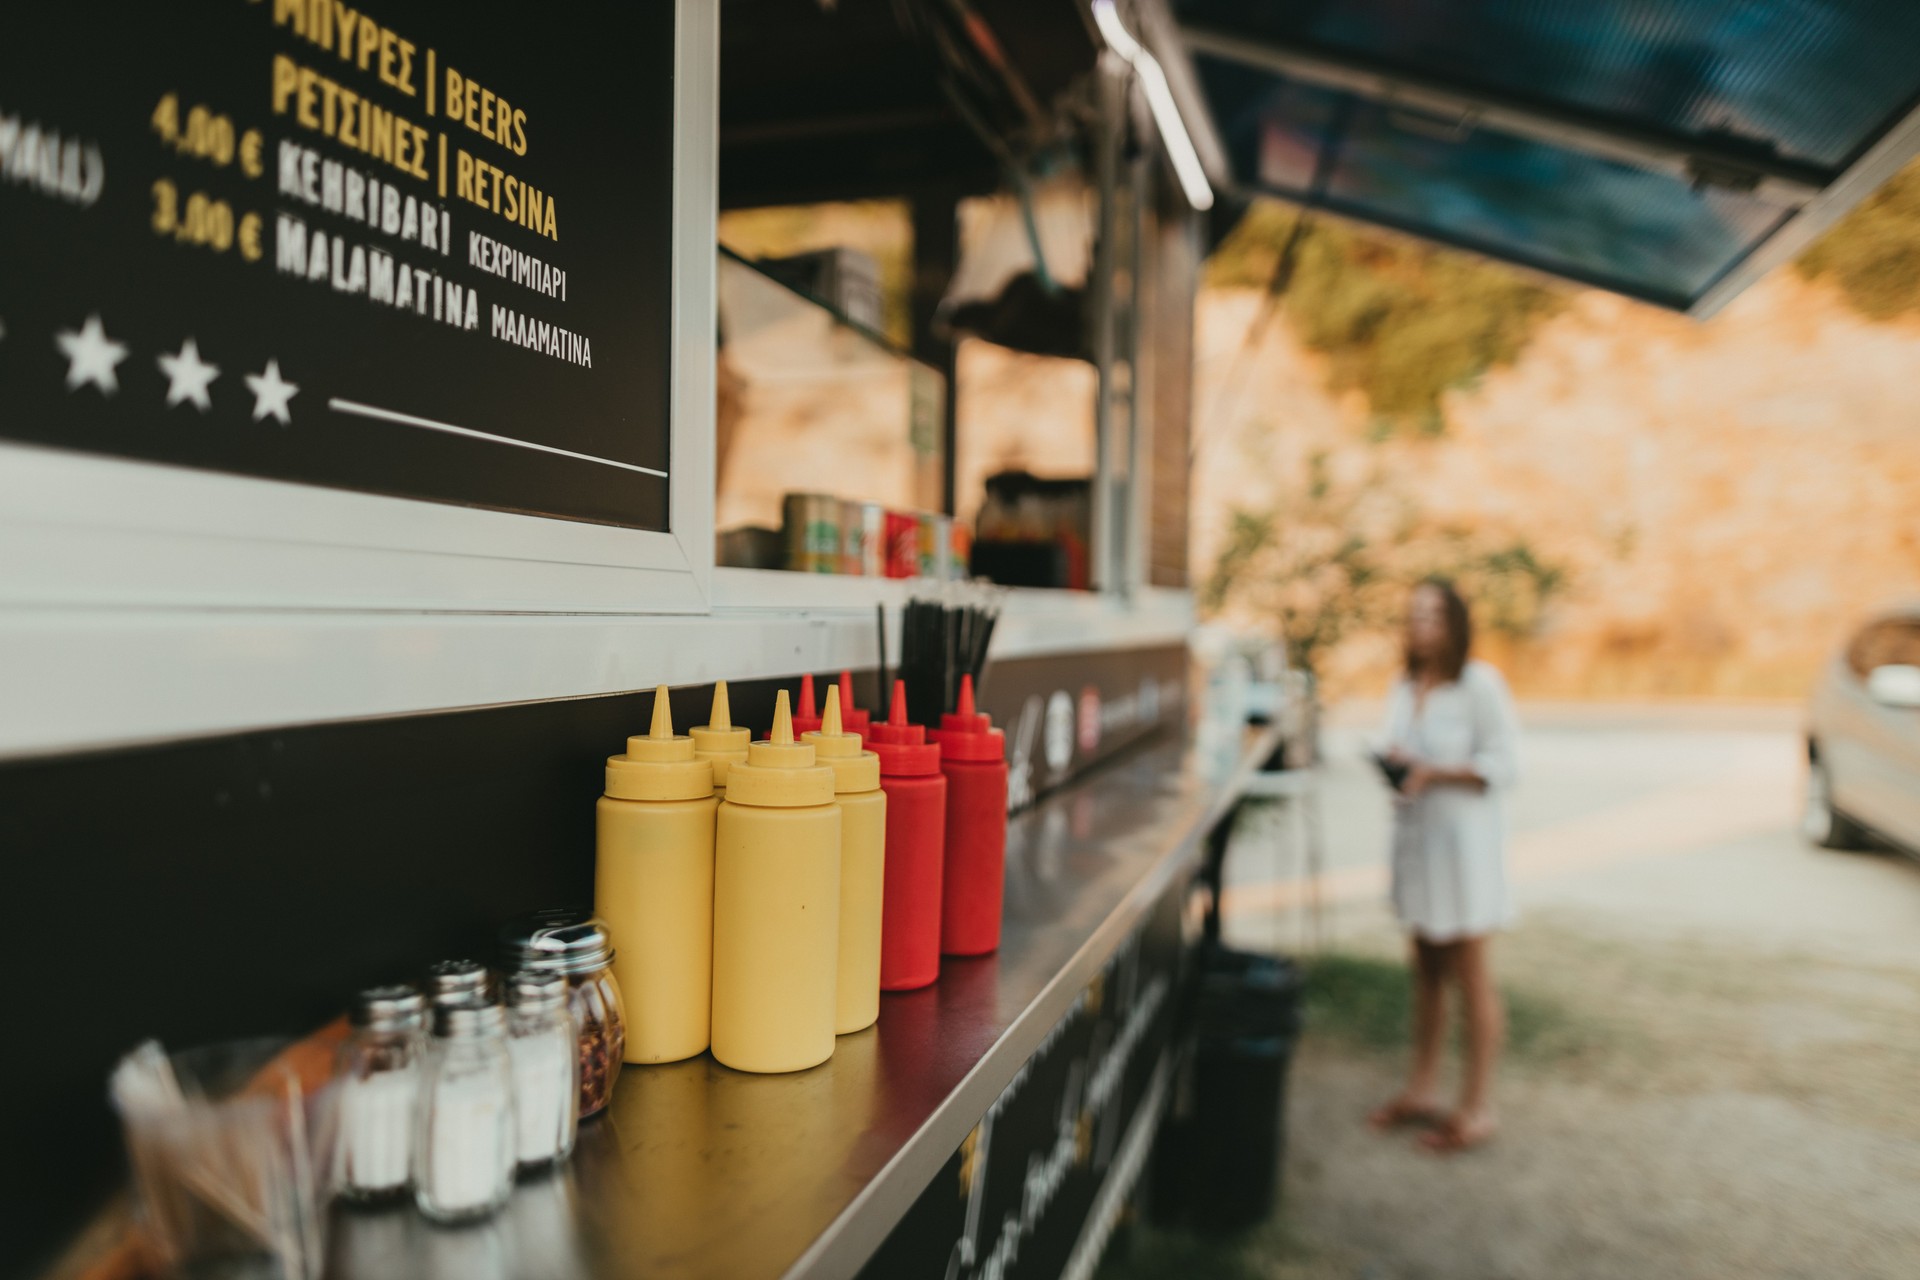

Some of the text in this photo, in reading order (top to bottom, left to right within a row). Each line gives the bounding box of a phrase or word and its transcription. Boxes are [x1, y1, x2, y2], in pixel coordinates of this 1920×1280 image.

[272, 53, 429, 181] ΡΕΤΣΙΝΕΣ
[457, 148, 558, 242] RETSINA
[445, 66, 527, 156] BEERS
[275, 211, 479, 331] MALAMATINA
[491, 303, 592, 369] ΜΑΛΑΜΑΤΙΝΑ
[277, 138, 450, 257] KEHRIBARI
[469, 230, 566, 302] ΚΕΧΡΙΜΠΑΡΙ
